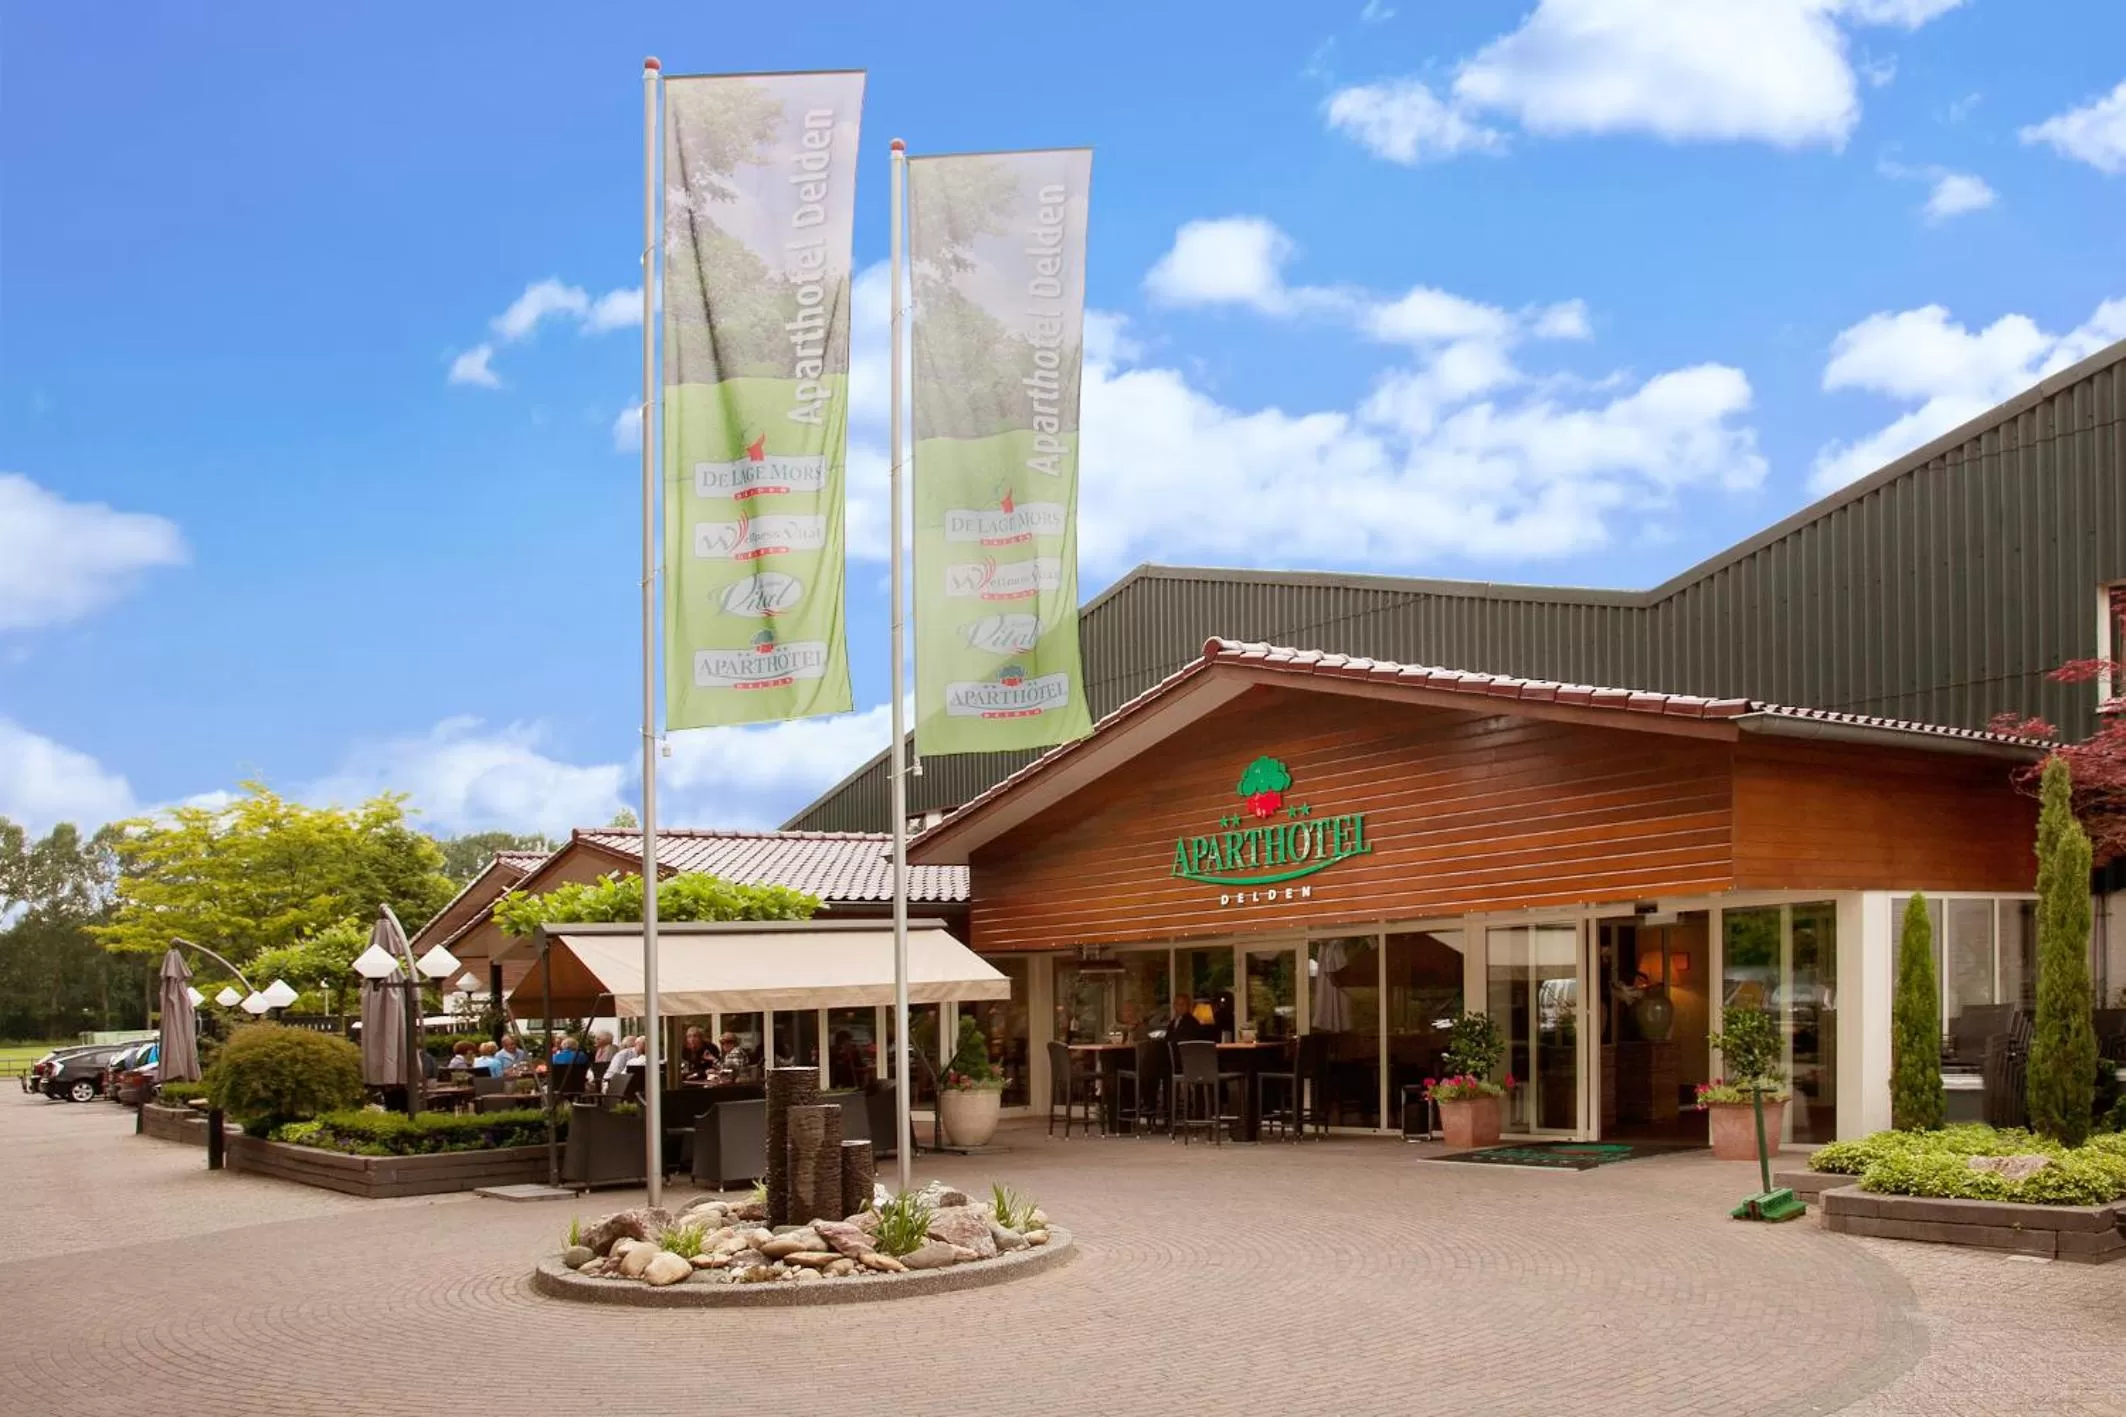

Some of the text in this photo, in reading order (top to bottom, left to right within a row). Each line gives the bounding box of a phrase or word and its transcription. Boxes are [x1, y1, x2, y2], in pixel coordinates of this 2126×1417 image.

[786, 107, 835, 425] Aparthotel Delden
[1022, 183, 1069, 477] Aparthotel Delden
[770, 462, 822, 481] MORS
[1170, 813, 1372, 876] APARTHOTEL
[1220, 886, 1312, 905] DELDEN
